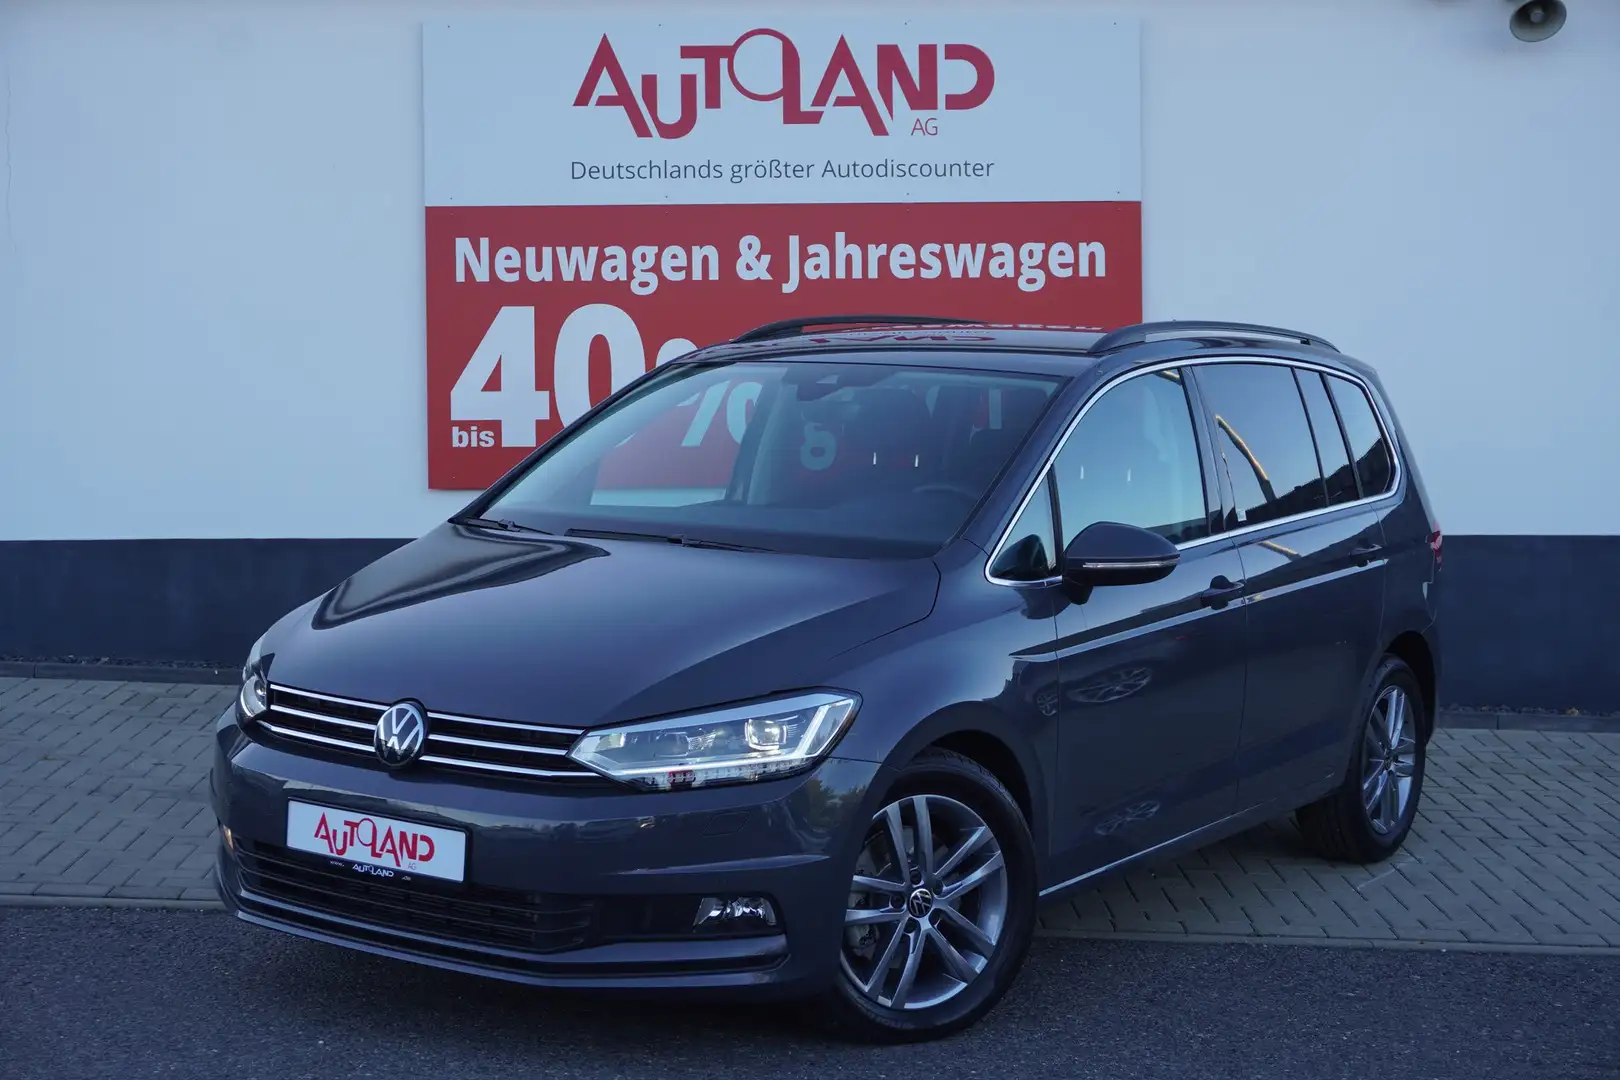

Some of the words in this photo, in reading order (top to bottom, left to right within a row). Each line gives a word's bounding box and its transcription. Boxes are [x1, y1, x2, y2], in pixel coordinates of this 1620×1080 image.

[573, 28, 996, 139] AUTOLAND
[911, 118, 938, 136] AG
[571, 160, 723, 180] Deutschlands
[730, 159, 815, 183] größter
[822, 158, 995, 179] Autodiscounter
[455, 238, 719, 296] Neuwagen
[736, 235, 774, 281] &
[781, 232, 1106, 294] Jahreswagen
[452, 426, 495, 448] bis
[314, 812, 435, 868] AUTOLAND
